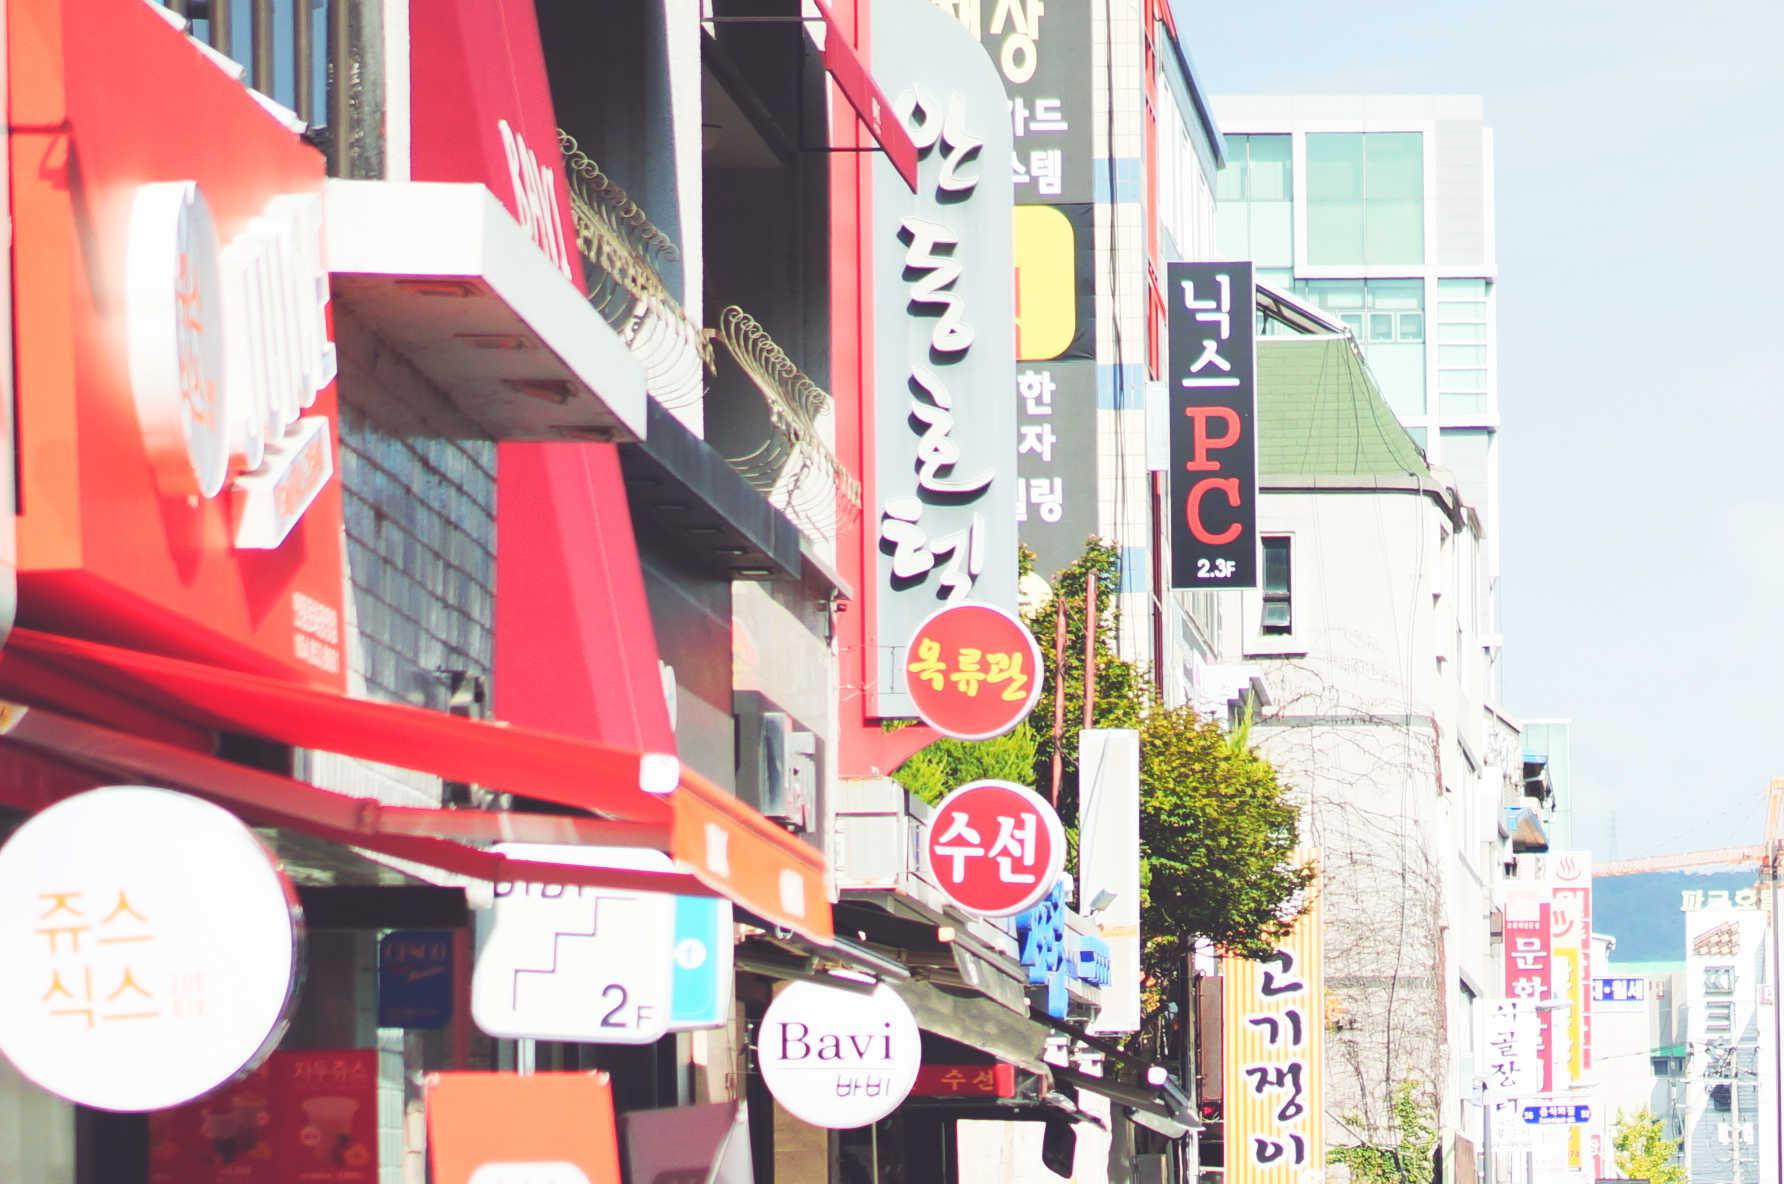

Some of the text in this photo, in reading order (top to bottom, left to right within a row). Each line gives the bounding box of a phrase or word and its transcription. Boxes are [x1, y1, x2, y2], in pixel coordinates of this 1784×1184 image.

[1180, 274, 1241, 388] 닉스
[1186, 405, 1242, 546] PC
[907, 636, 1029, 703] 옥류관
[933, 811, 1037, 884] 수선
[33, 889, 156, 955] 쥬스
[40, 965, 160, 1028] 식스
[776, 1021, 896, 1061] Bavi
